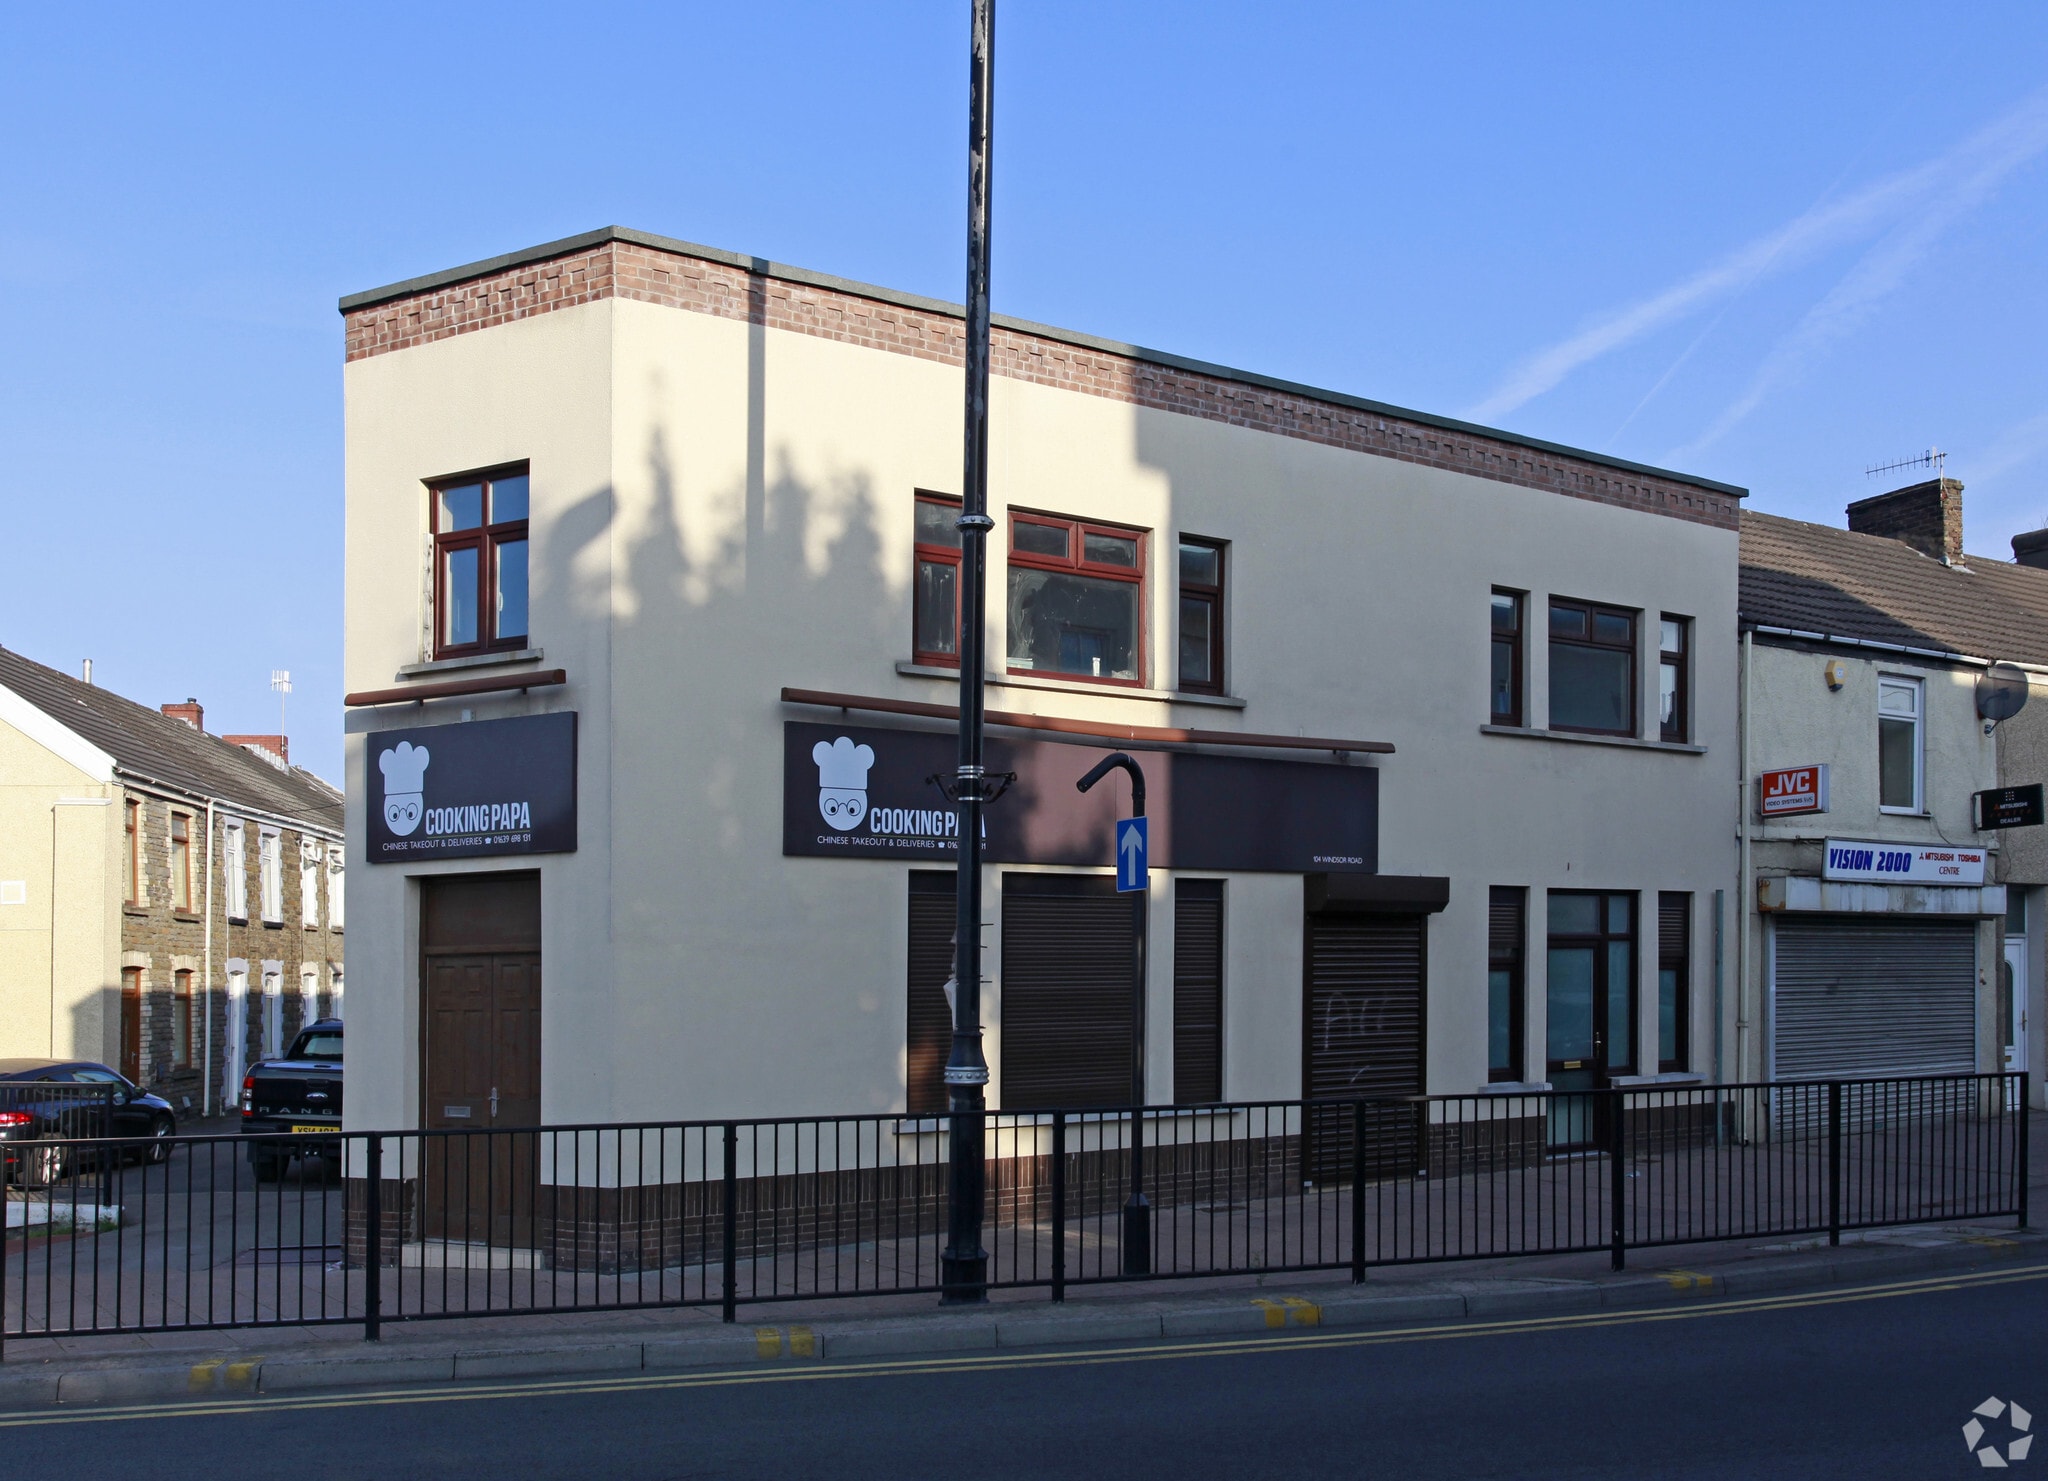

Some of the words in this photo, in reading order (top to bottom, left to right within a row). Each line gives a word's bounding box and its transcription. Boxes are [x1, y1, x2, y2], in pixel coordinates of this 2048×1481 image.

[1770, 771, 1810, 795] JVC
[1766, 799, 1781, 807] VIDEO
[1781, 797, 1803, 805] SYSTEMS
[425, 804, 489, 835] COOKING
[491, 801, 531, 830] PAPA
[870, 807, 943, 836] COOKING
[382, 841, 408, 851] CHINESE
[409, 839, 439, 849] TAKEOUT
[440, 839, 446, 848] &
[447, 837, 482, 847] DELIVERIES
[817, 835, 849, 845] CHINESE
[851, 837, 886, 847] TAKEOUT
[888, 838, 895, 848] &
[896, 838, 935, 849] DELIVERIES
[1829, 848, 1874, 871] VISION
[1876, 851, 1912, 872] 2000
[1925, 852, 1955, 862] MITSUBISHI
[1958, 854, 1982, 863] TOSHIBA
[1938, 866, 1961, 876] CENTRE
[259, 1106, 333, 1115] RANG
